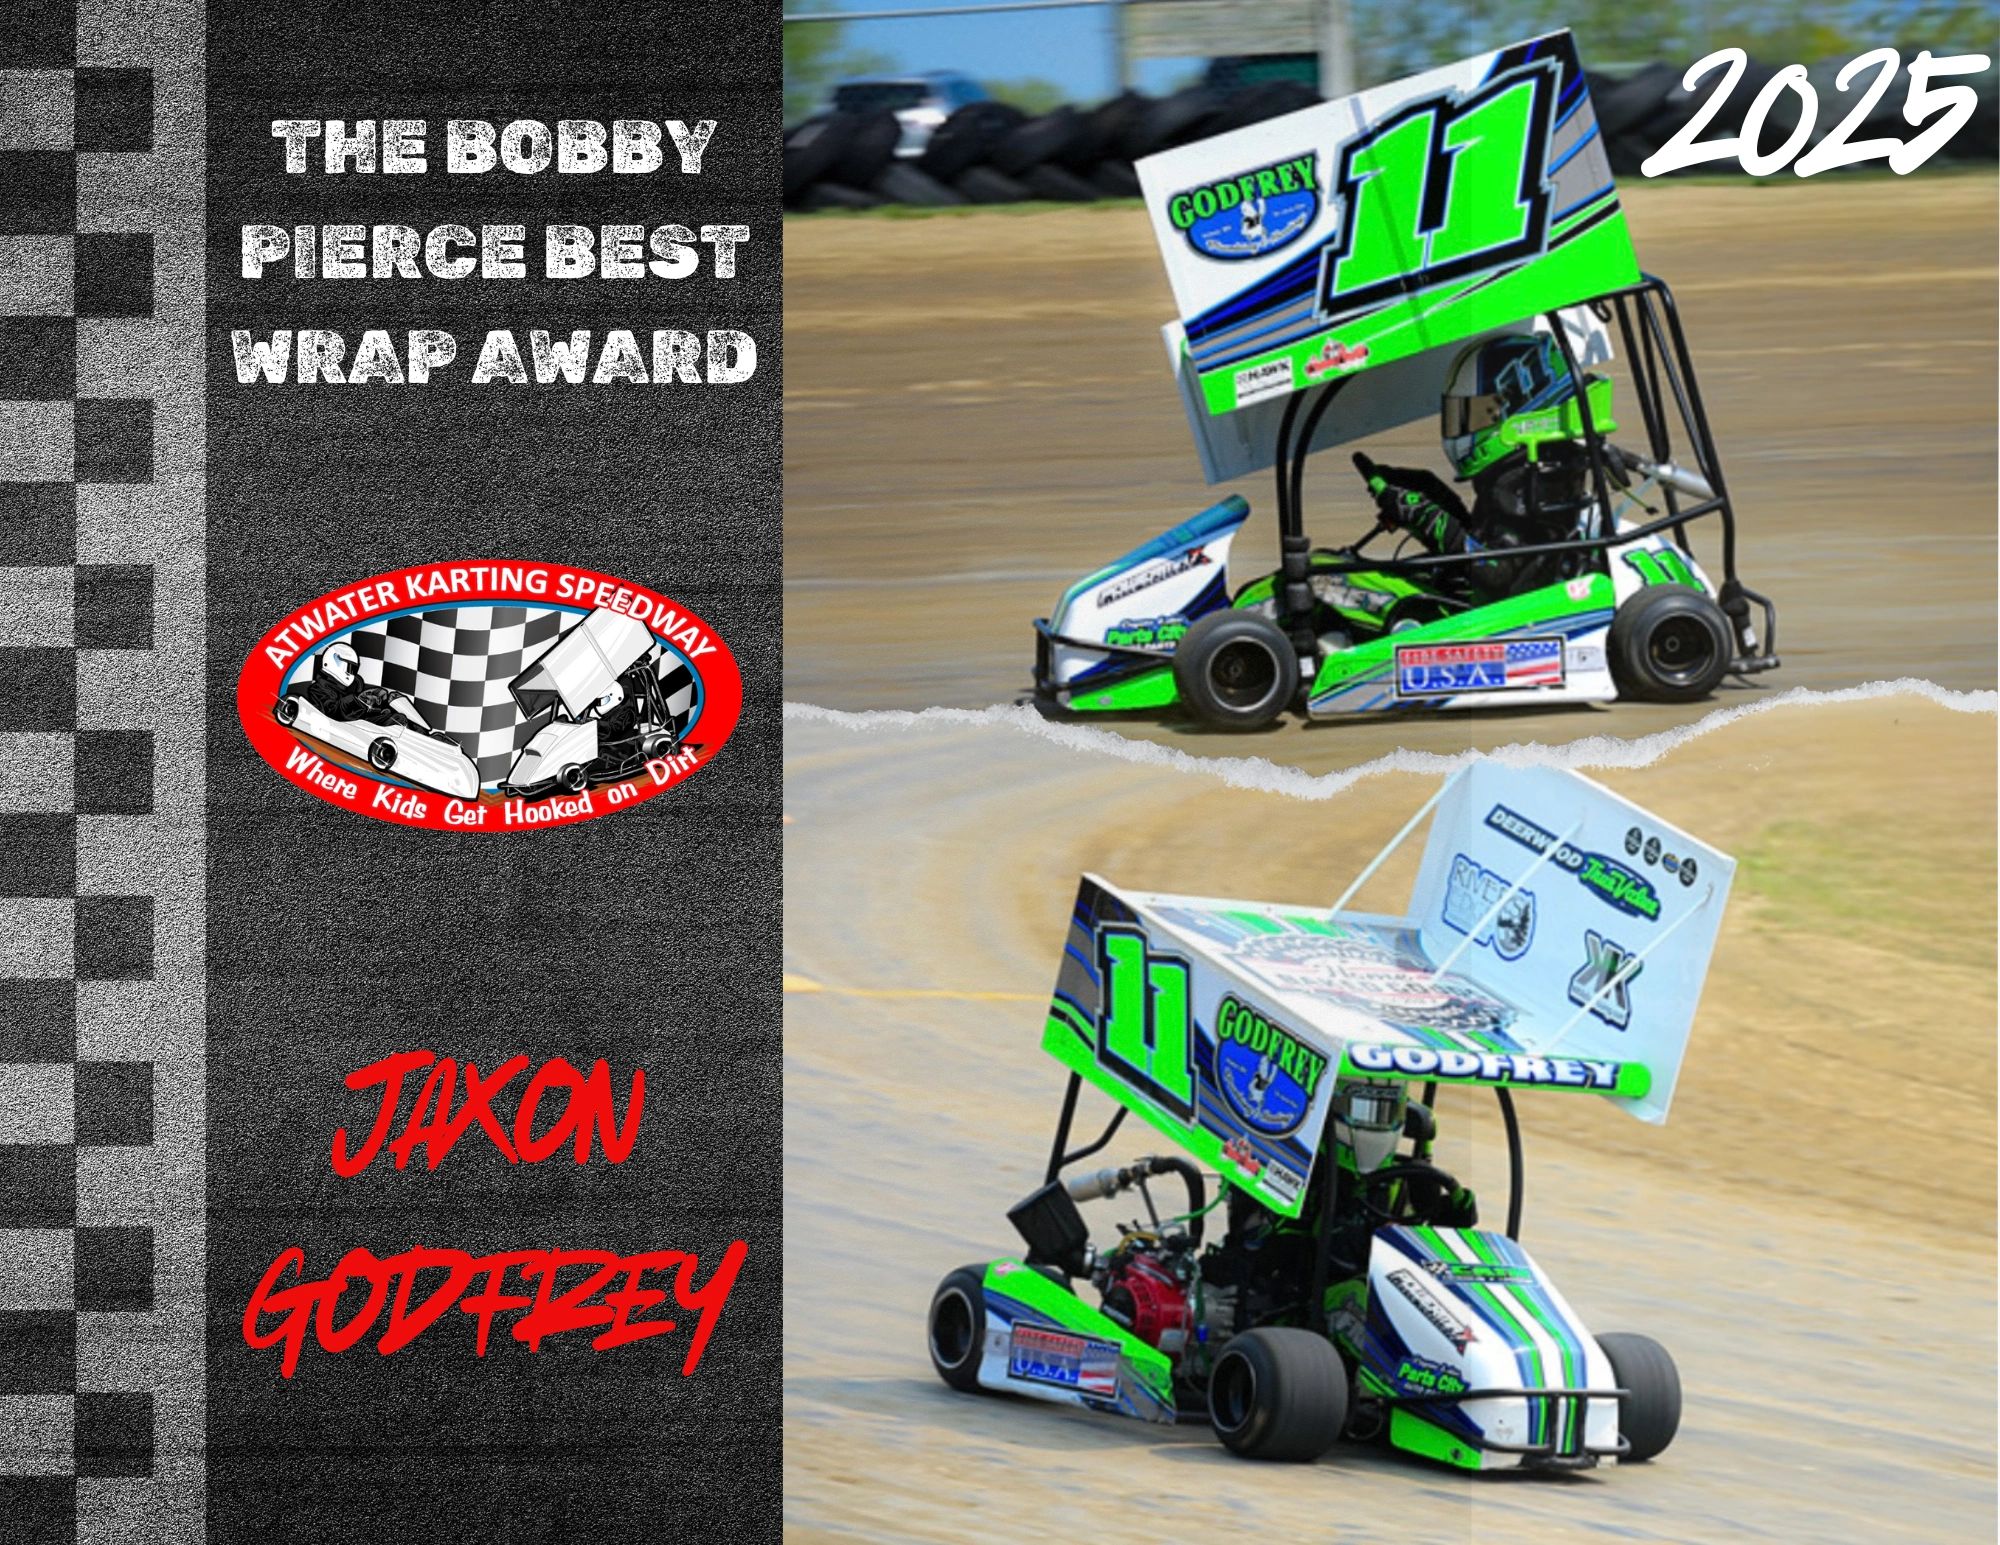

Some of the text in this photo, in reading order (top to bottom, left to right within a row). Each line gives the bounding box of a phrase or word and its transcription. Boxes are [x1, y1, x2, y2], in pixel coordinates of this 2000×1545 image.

[1169, 155, 1316, 229] GODFREY
[1326, 74, 1542, 300] 11
[1405, 662, 1501, 690] U.S.A.
[1488, 809, 1583, 869] DEERWOD
[1103, 931, 1193, 1110] 11
[1217, 1000, 1325, 1096] GODFREY
[1350, 1044, 1619, 1087] GODFREY
[1398, 1362, 1436, 1388] Parts
[1437, 1375, 1466, 1394] City
